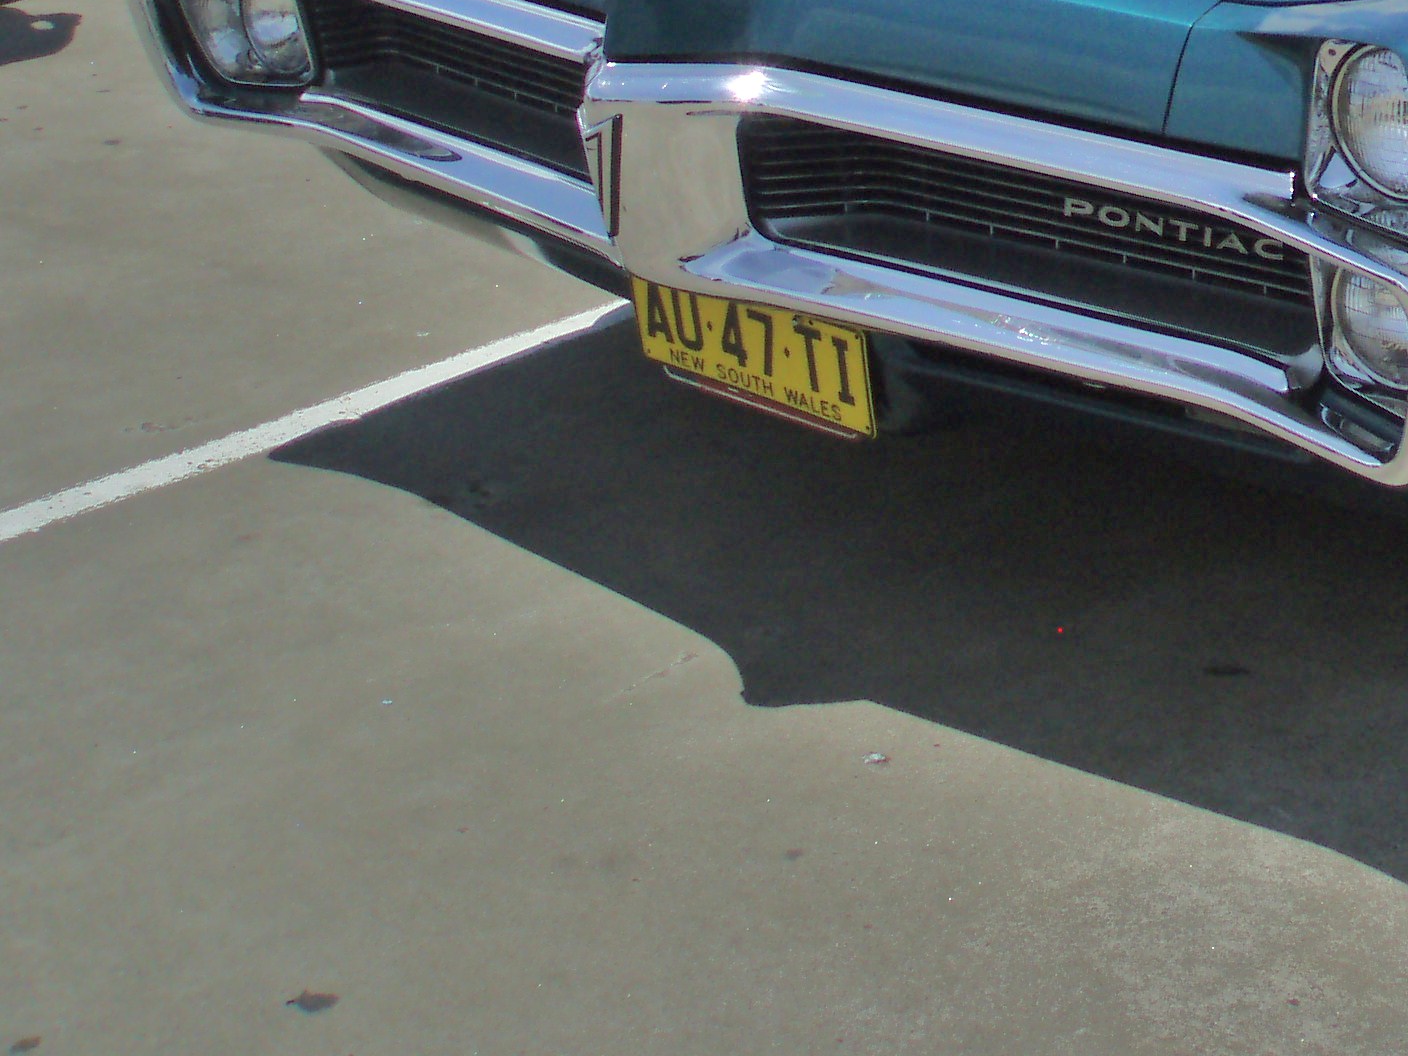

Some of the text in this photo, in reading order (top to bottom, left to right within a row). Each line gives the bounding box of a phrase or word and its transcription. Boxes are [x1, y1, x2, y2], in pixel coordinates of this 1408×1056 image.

[1063, 196, 1285, 261] PONTIAC
[668, 347, 843, 422] NEW SOUTH WALES
